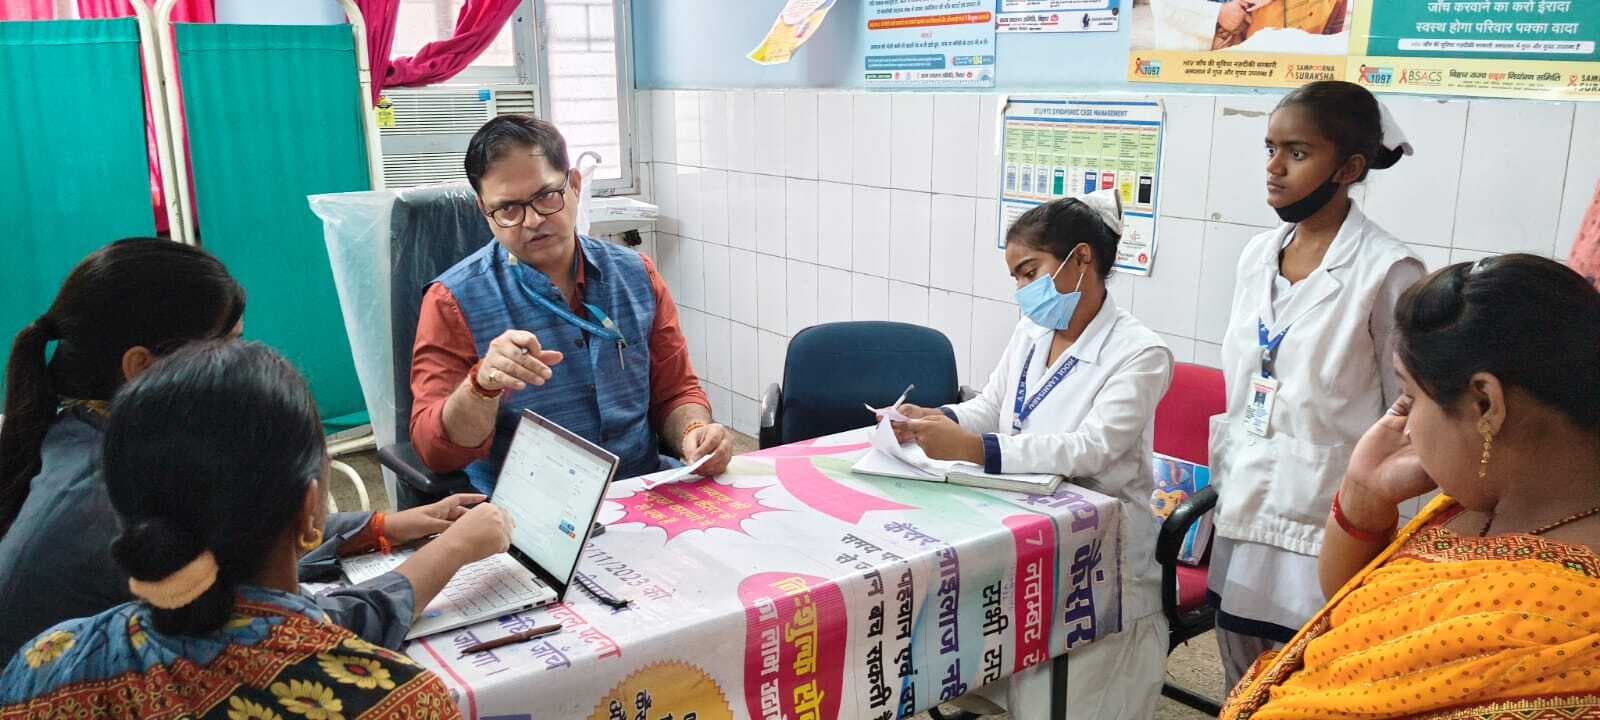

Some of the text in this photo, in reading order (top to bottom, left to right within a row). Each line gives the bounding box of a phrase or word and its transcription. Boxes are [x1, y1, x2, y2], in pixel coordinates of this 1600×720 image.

[1494, 1, 1508, 13] का
[1416, 19, 1578, 34] स्वस्थ होगा परिवार पक्का वादा
[1296, 72, 1334, 80] SURAKSHA
[1371, 74, 1392, 83] 1097
[1408, 70, 1443, 82] BSACS
[1024, 529, 1045, 546] 7
[895, 568, 914, 640] पहचान
[982, 581, 1009, 637] सभी
[1023, 558, 1044, 644] नवम्बर
[1064, 538, 1105, 649] कैंसर
[866, 601, 884, 638] बच
[760, 626, 780, 675] लाभ
[895, 643, 918, 678] एवं
[865, 642, 892, 710] सकती
